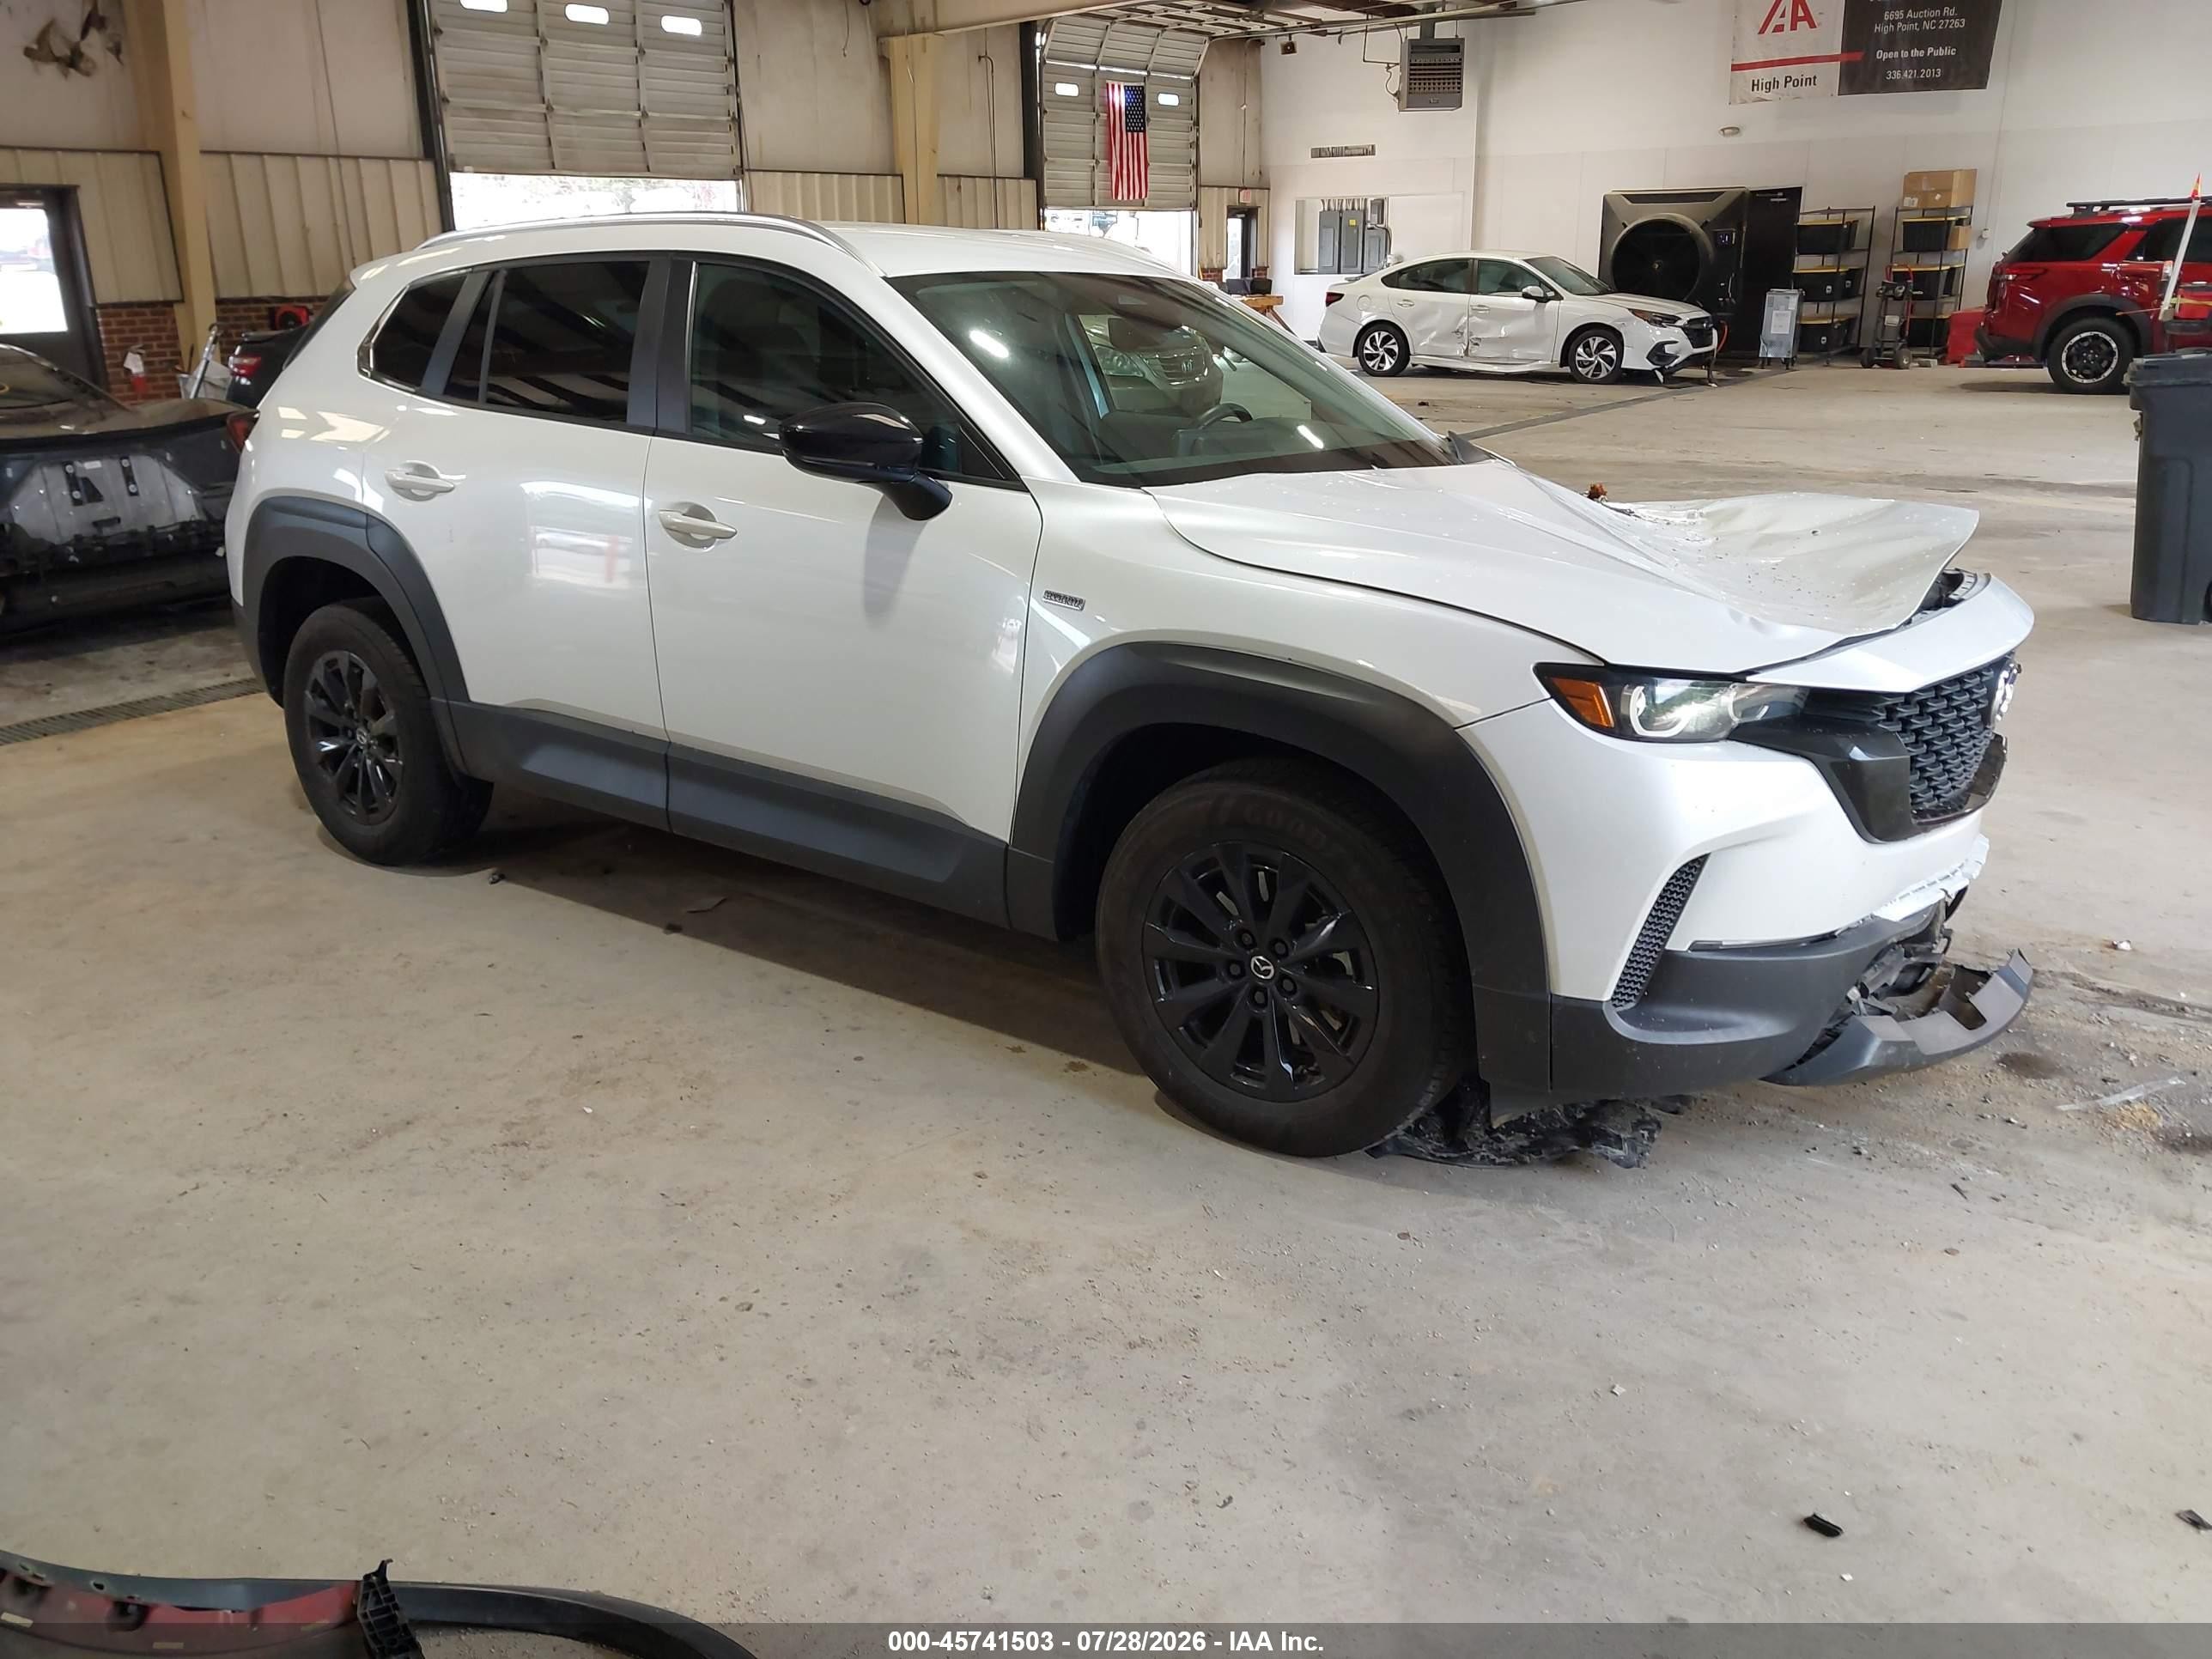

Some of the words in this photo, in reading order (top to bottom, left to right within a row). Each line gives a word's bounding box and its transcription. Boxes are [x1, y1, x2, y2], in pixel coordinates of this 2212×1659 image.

[1884, 10, 1904, 21] 6695
[1906, 9, 1941, 19] Auction
[1943, 7, 1958, 16] Rd.
[1875, 23, 1894, 34] High
[1897, 21, 1920, 31] Point,
[1923, 20, 1936, 29] NC
[1938, 18, 1965, 29] 27263
[1876, 50, 1899, 61] Open
[1911, 48, 1924, 58] the
[1927, 46, 1956, 57] Public
[1887, 69, 1942, 80] 336.421.2013
[1752, 77, 1779, 93] High
[1784, 74, 1817, 88] Point
